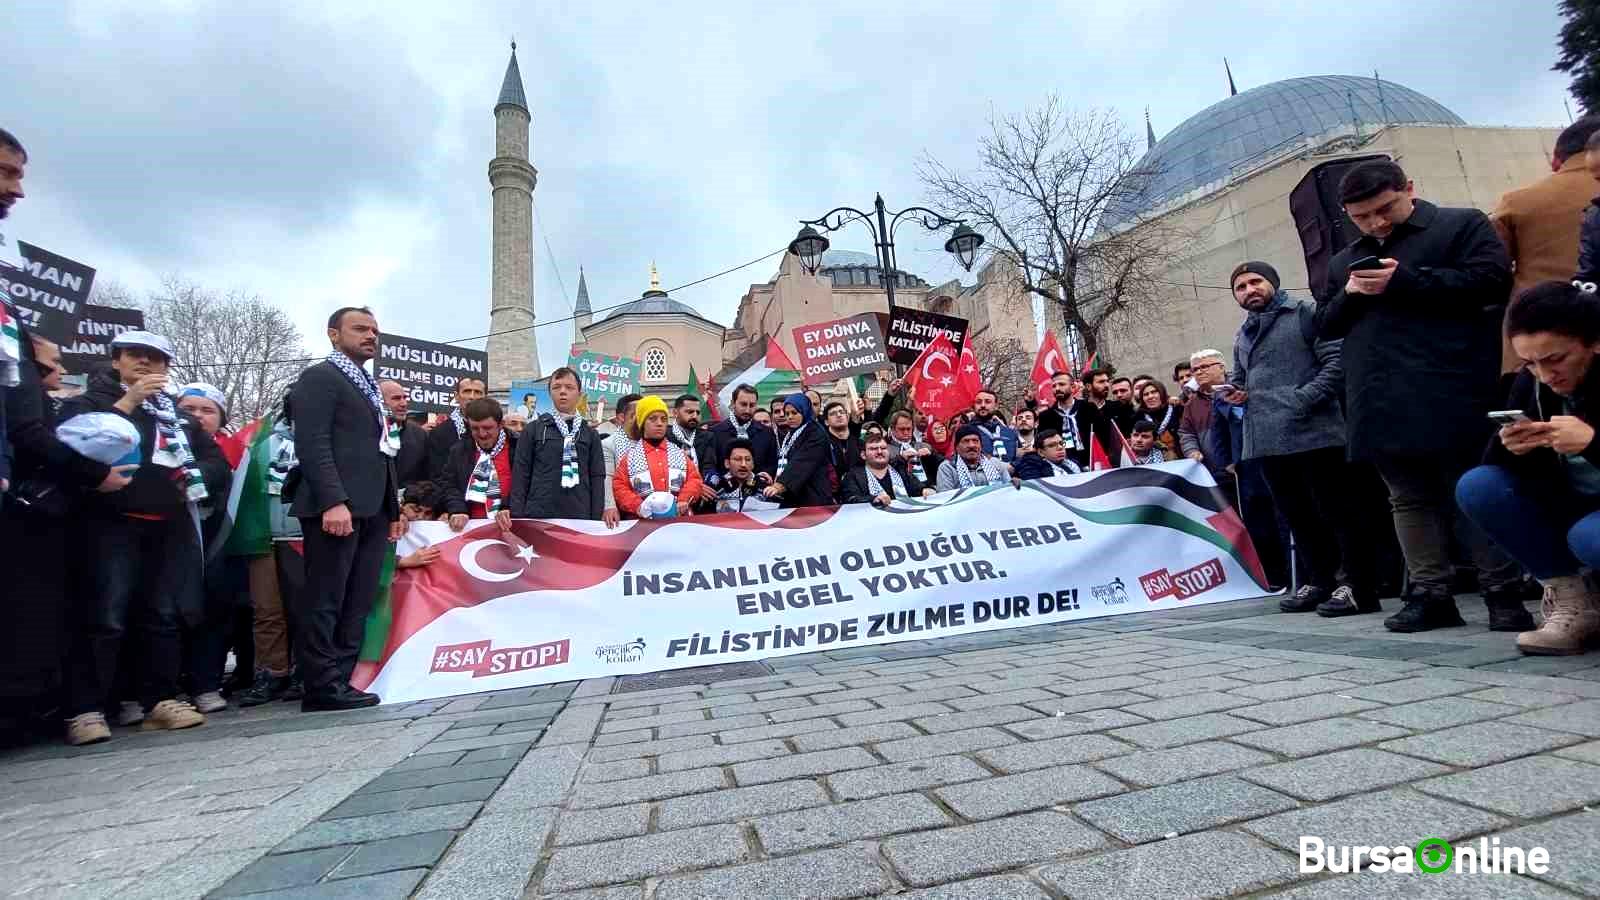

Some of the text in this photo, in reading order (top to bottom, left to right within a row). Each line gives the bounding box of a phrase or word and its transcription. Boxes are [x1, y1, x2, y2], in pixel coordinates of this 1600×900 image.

[803, 321, 871, 343] EY DÜNYA
[381, 344, 482, 372] MÜSLÜMAN
[806, 336, 876, 359] DAHA KAÇ
[379, 366, 431, 384] ZULME
[580, 359, 630, 379] ÖZGÜR
[806, 352, 885, 376] ÇOCUK ÖLMELİ?
[623, 521, 1082, 596] İNSANLIĞIN OLDUĞU YERDE
[736, 559, 1008, 616] ENGEL YOKTUR.
[1143, 572, 1173, 597] #SAY
[1174, 562, 1222, 596] STOP!
[665, 618, 858, 658] FİLİSTİN'DE
[867, 603, 965, 638] ZULME
[973, 595, 1031, 623] DUR
[1037, 588, 1080, 615] DE!
[434, 644, 561, 673] #SAY STOP!
